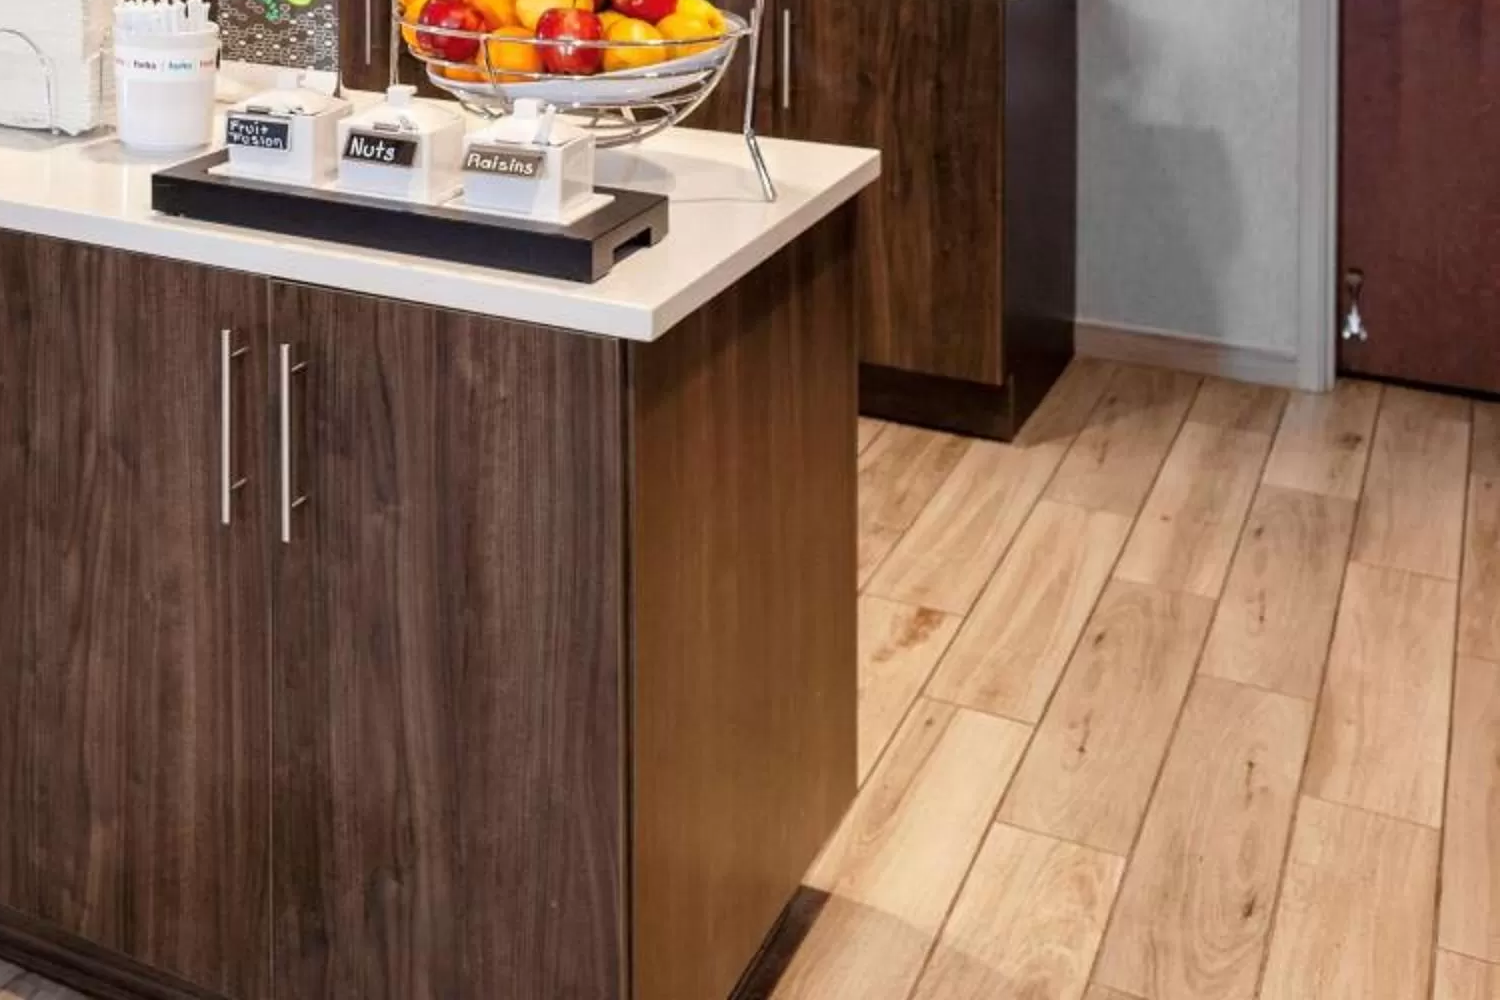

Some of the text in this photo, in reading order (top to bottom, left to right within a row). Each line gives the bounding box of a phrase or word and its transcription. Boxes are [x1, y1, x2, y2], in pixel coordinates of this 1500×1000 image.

[229, 120, 269, 135] Fruit
[350, 136, 396, 162] Nuts
[467, 152, 534, 176] Raisins
